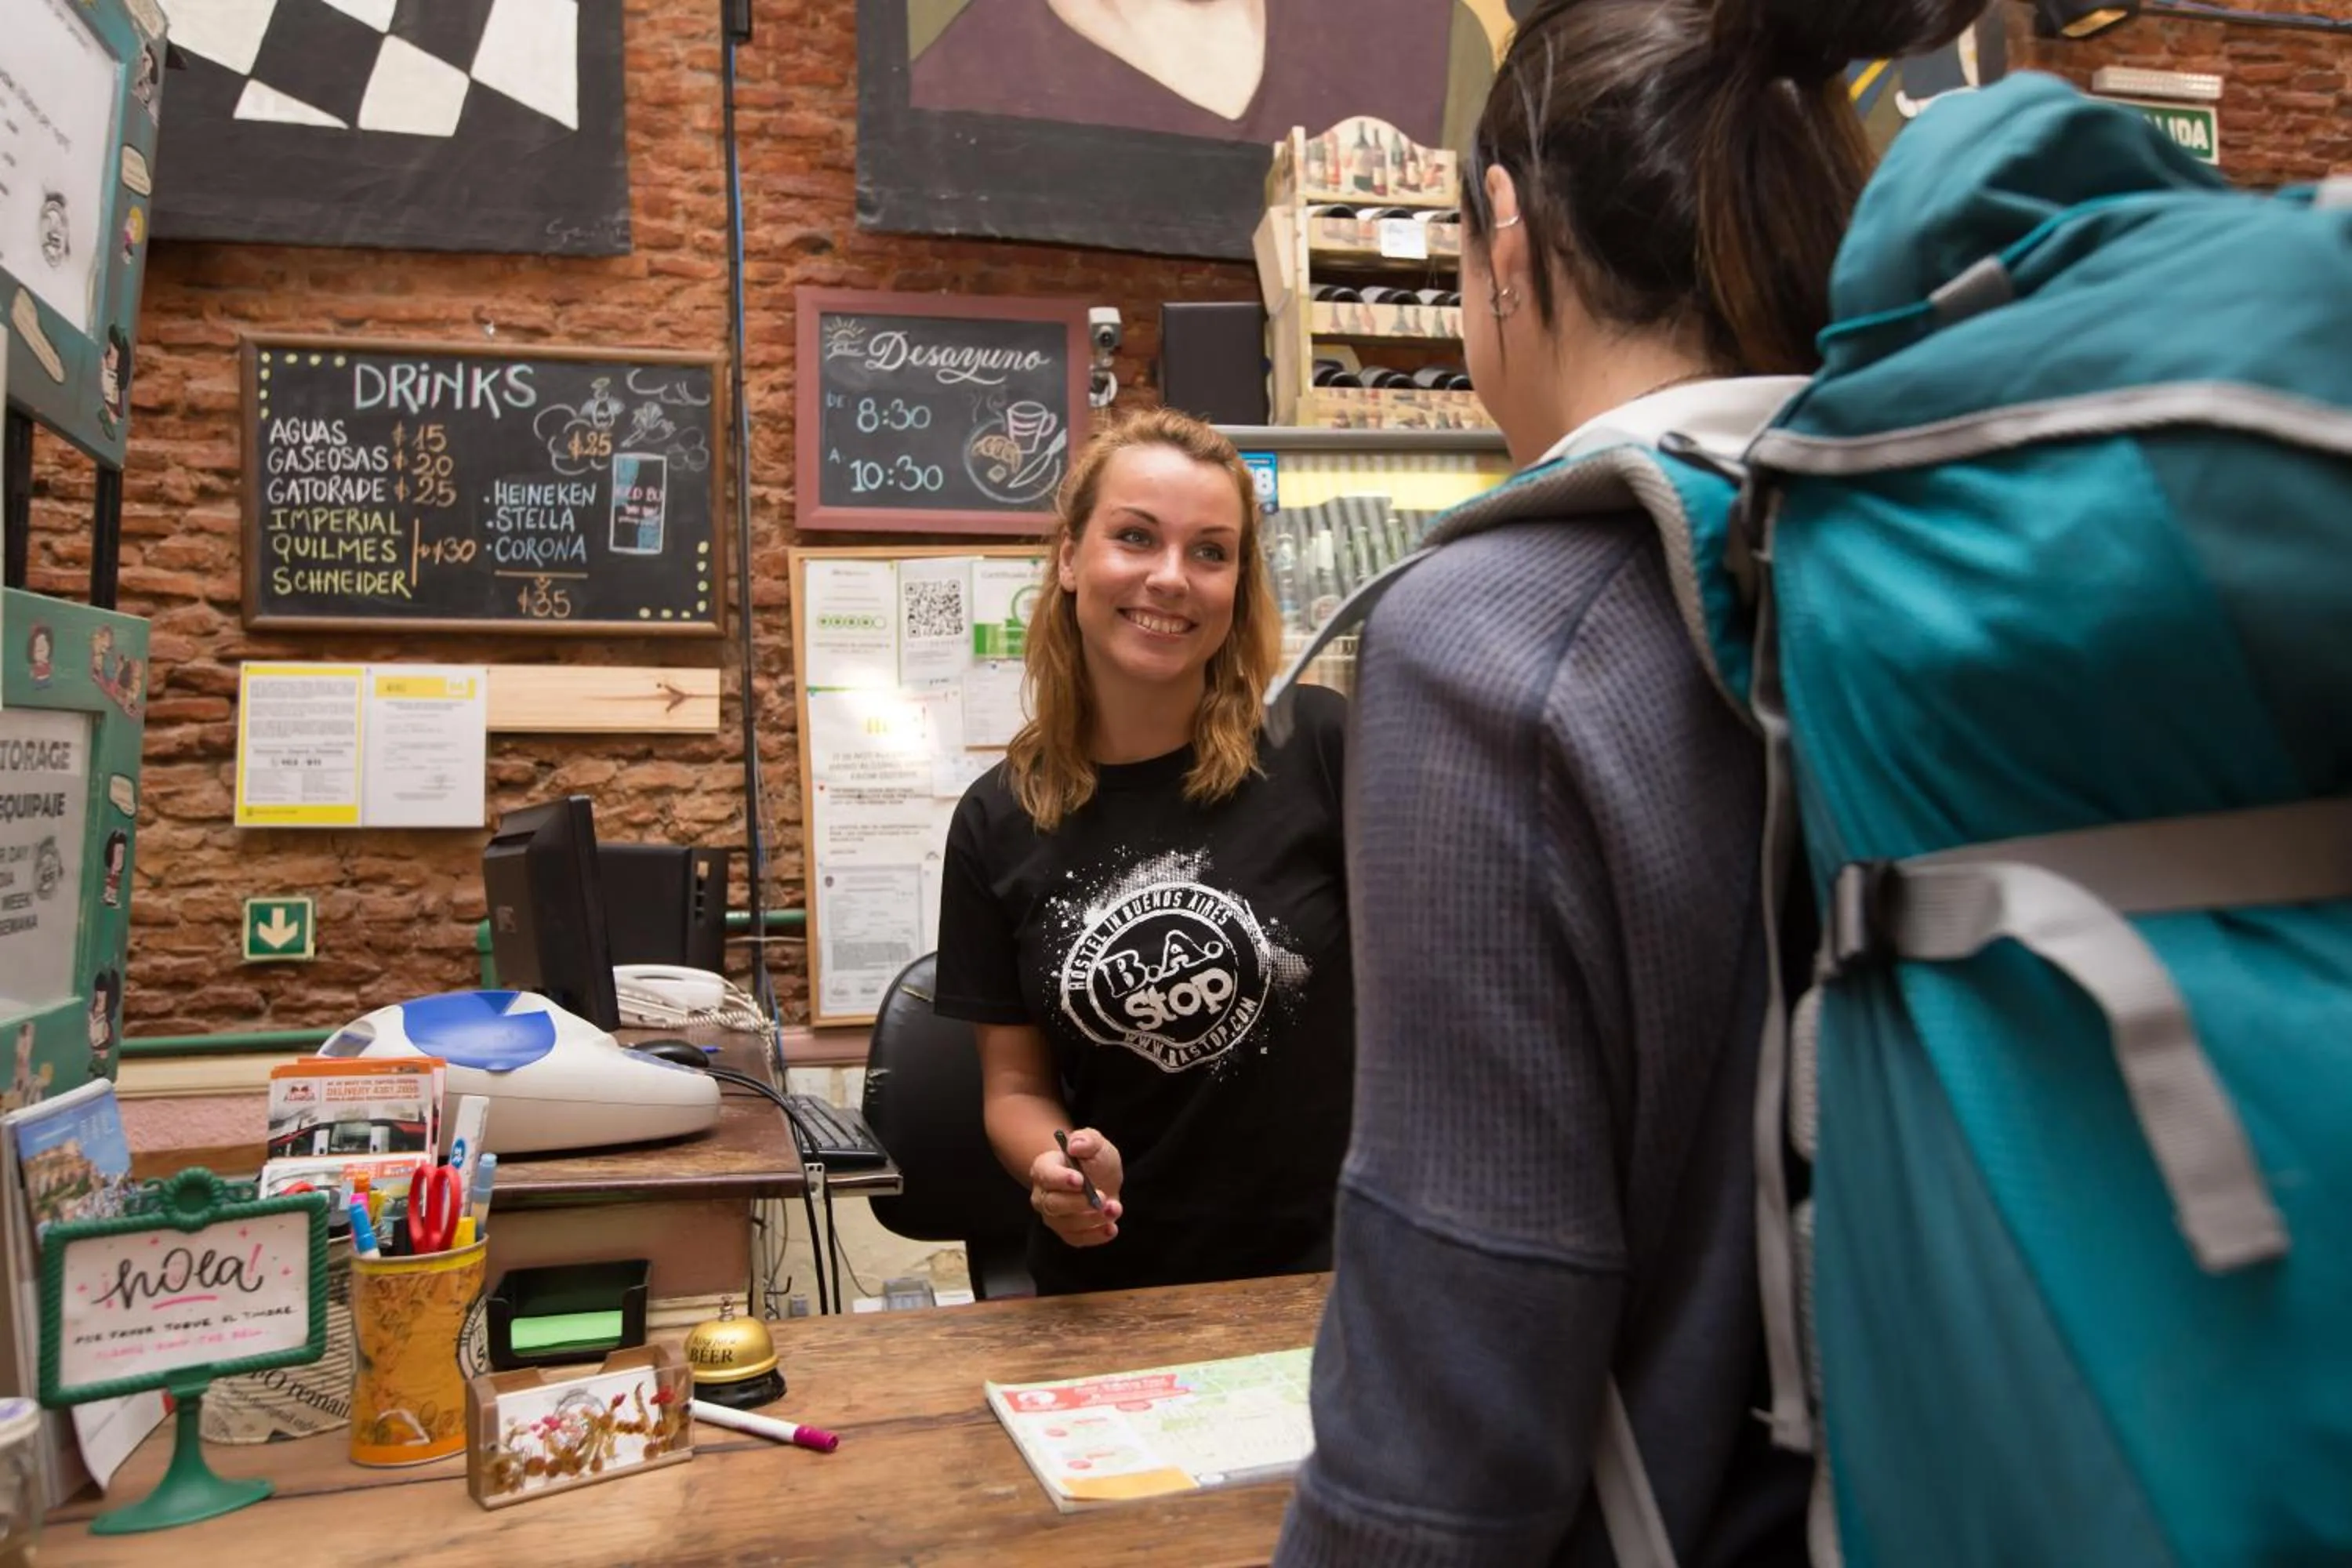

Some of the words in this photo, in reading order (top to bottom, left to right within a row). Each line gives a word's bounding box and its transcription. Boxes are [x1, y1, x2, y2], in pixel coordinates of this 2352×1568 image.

[865, 330, 1051, 385] Desayuno
[857, 397, 932, 433] 8:30
[269, 417, 348, 445] AGUAS
[267, 445, 389, 474] GASEOSAS
[849, 455, 944, 492] 10:30
[267, 474, 388, 506] GATORADE
[495, 480, 597, 508] HEINEKEN
[267, 506, 403, 535] IMPERIAL
[496, 506, 576, 533] STELLA
[272, 533, 397, 564] QUILMES
[495, 533, 587, 568] CORONA
[273, 567, 412, 599] SCHNEIDER
[0, 740, 71, 771] TORAGE
[1068, 931, 1109, 991] HOSTEL
[1105, 913, 1124, 933] IN
[1121, 891, 1183, 921] BUENOS
[1187, 892, 1232, 926] AIRES
[1124, 996, 1258, 1068] WWW.BASTOP.COM
[689, 1348, 734, 1363] BEER
